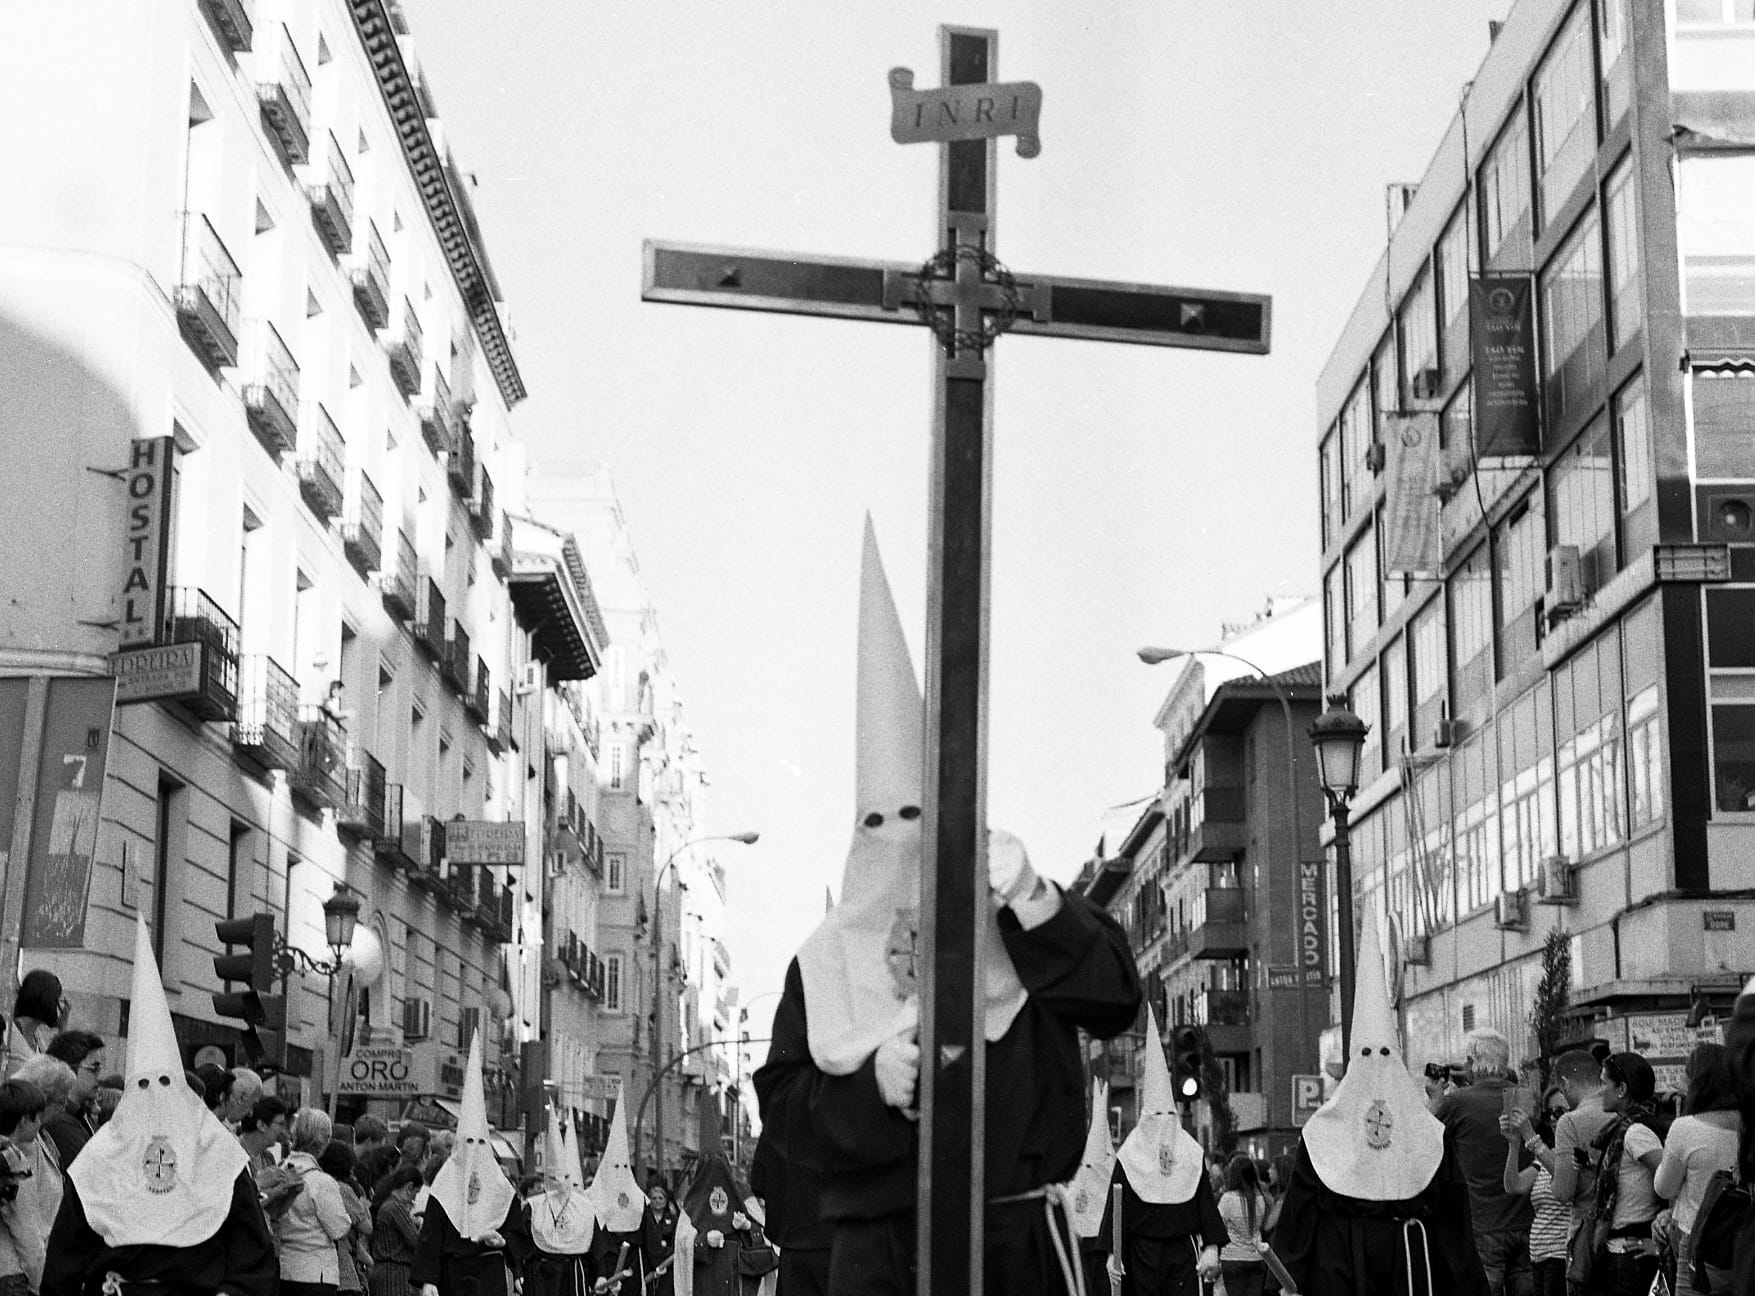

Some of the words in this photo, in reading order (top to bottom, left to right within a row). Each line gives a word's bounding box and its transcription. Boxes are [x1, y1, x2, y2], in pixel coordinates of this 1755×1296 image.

[914, 95, 1019, 128] INRI
[123, 442, 154, 624] HOSTAL
[63, 753, 87, 788] 7
[1300, 863, 1319, 966] MERCADO
[355, 1049, 402, 1059] COMPRO
[350, 1060, 408, 1081] ORO
[339, 1081, 376, 1091] ANTON
[379, 1081, 418, 1092] MARTIN
[1298, 1079, 1320, 1109] P
